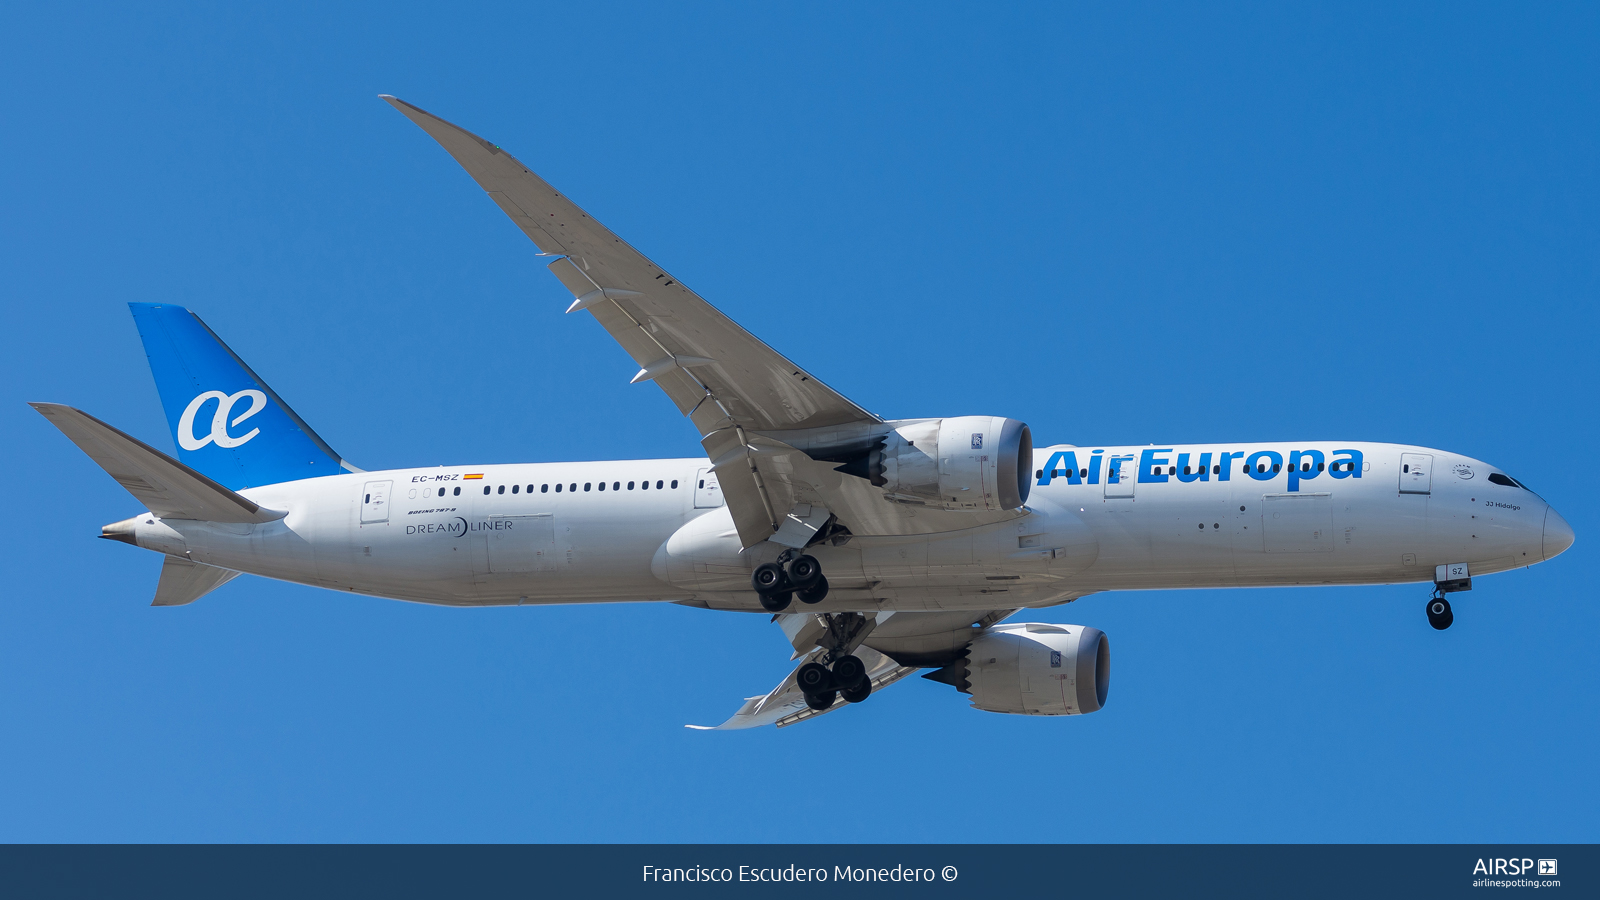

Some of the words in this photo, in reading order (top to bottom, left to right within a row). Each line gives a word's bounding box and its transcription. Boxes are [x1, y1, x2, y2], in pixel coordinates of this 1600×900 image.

[411, 473, 460, 483] EC-MSZ
[1495, 502, 1521, 511] Hidalgo
[1452, 567, 1463, 575] SZ
